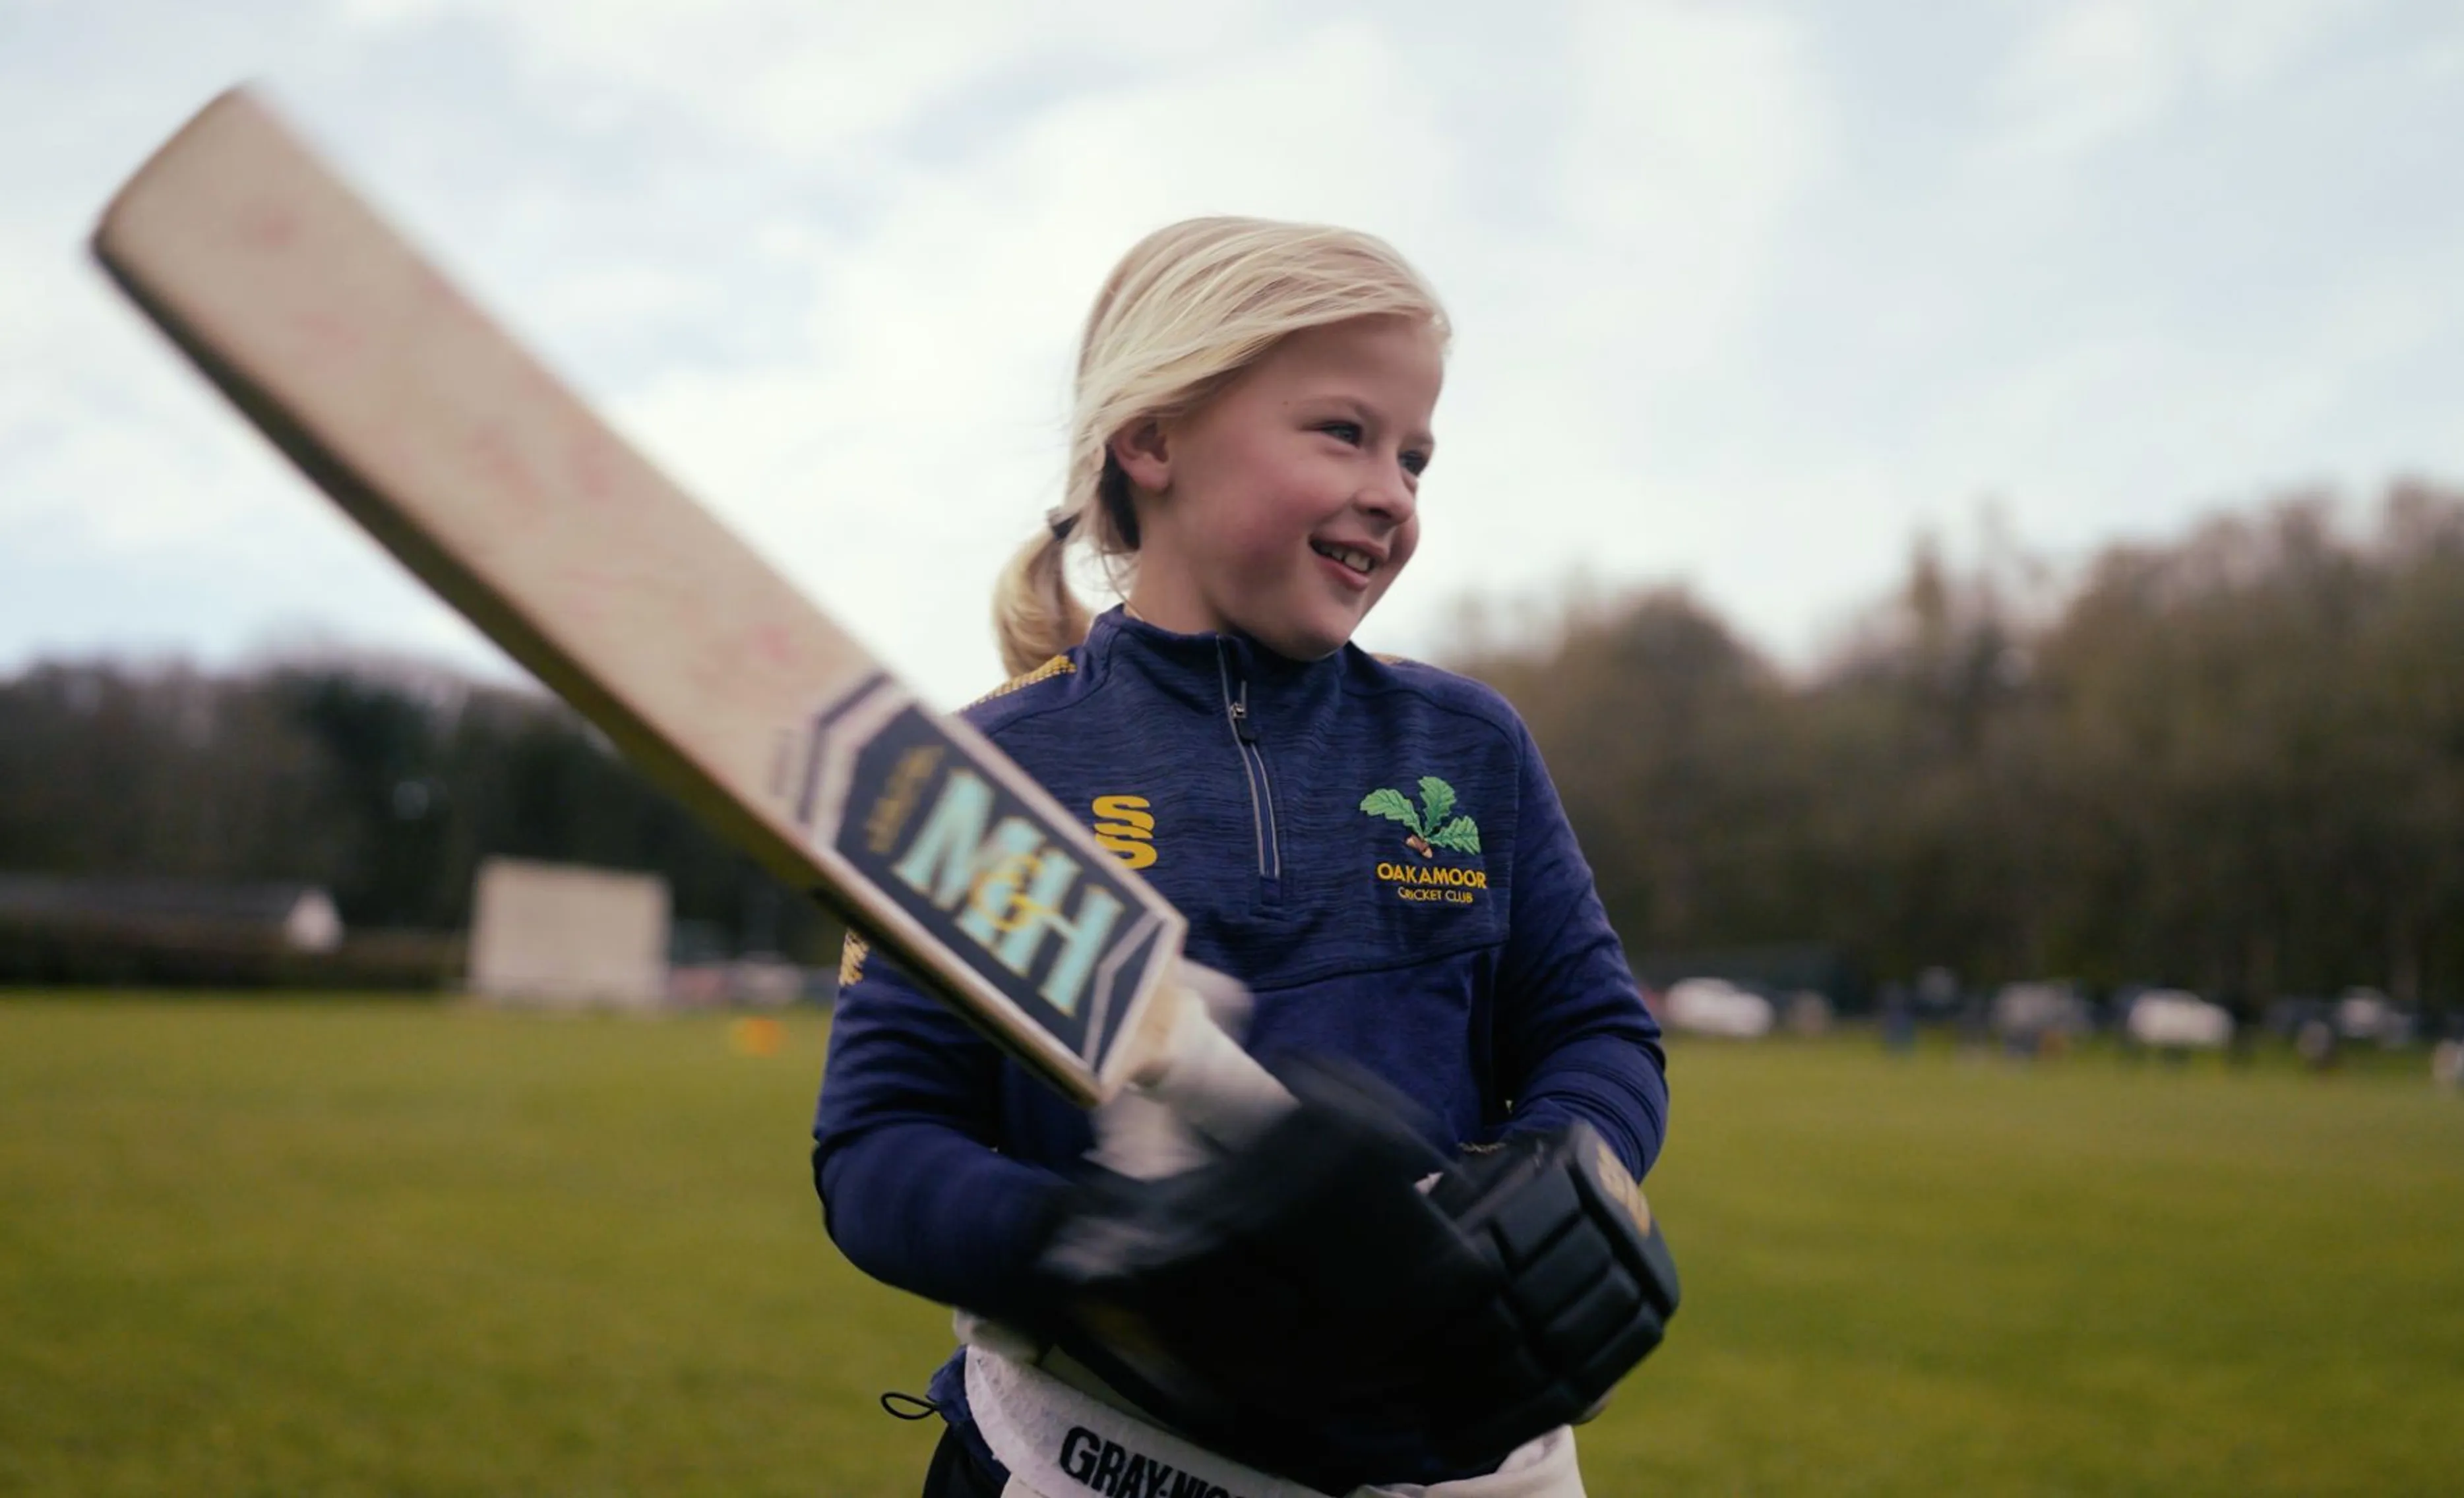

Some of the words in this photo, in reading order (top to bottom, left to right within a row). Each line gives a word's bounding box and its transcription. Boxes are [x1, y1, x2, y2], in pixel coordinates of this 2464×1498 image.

[1376, 862, 1487, 889] OAKAMOOR
[1398, 887, 1442, 901] CRICKET
[1445, 889, 1473, 903] CLUB
